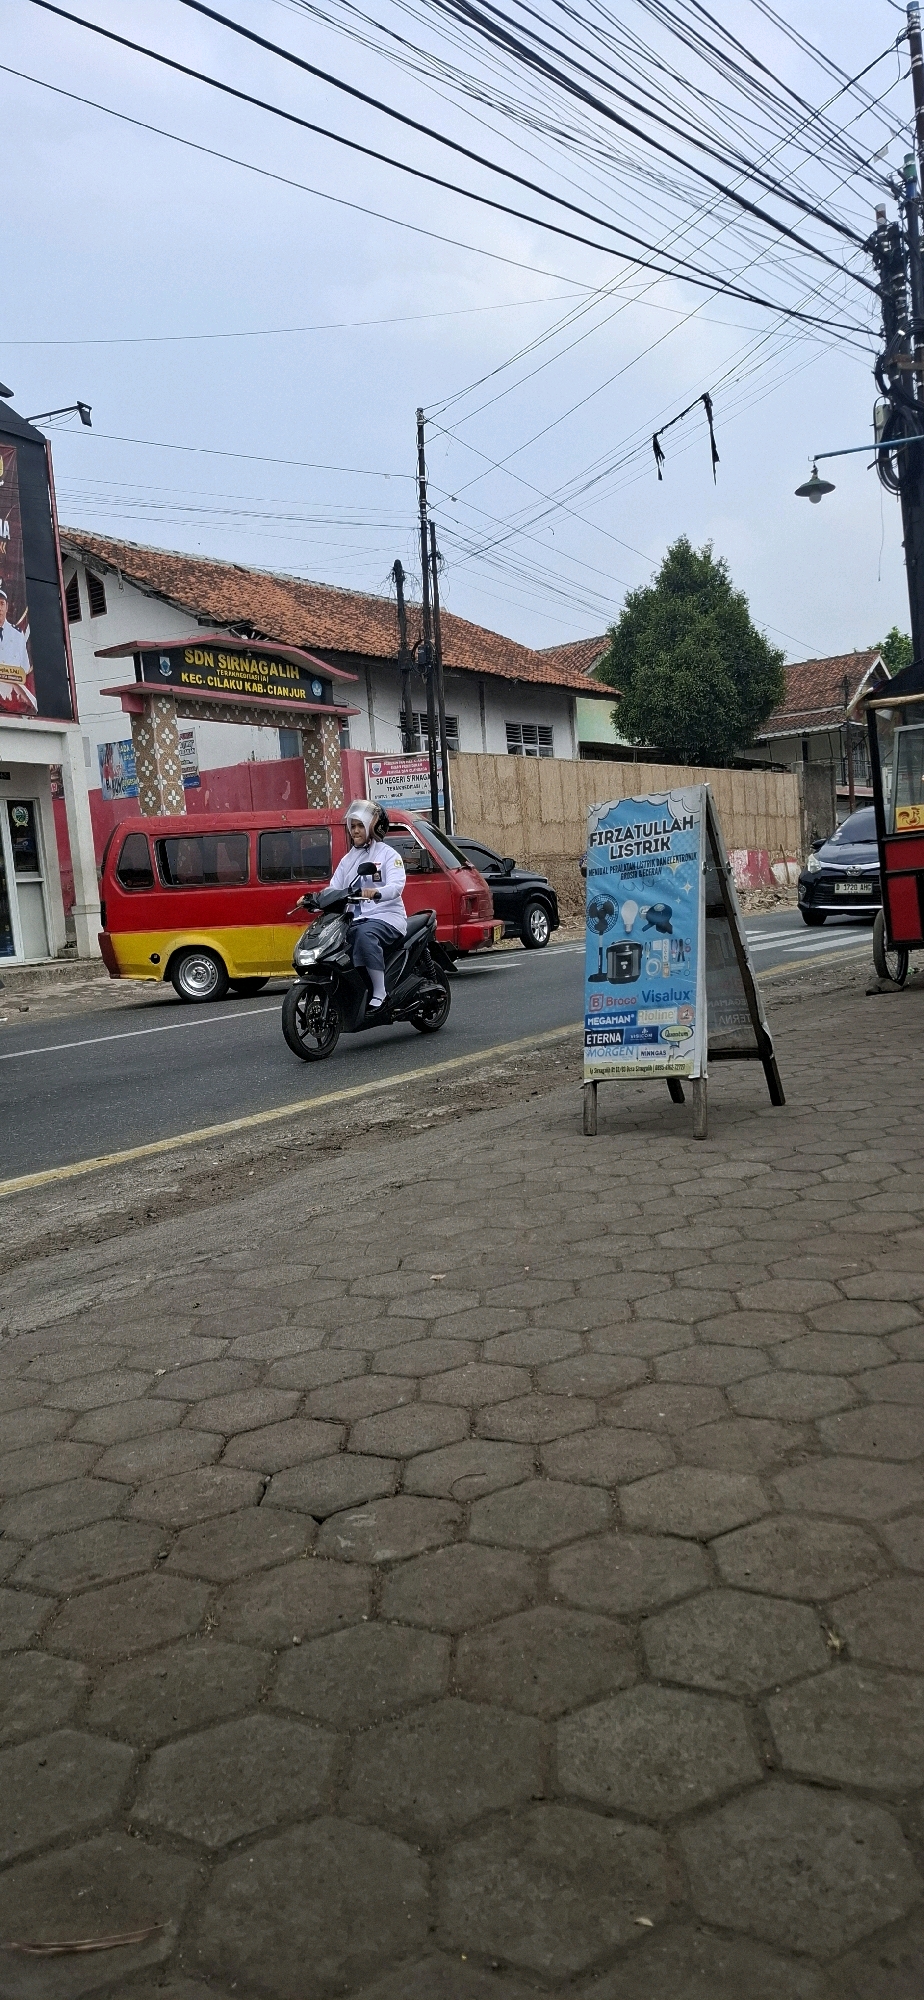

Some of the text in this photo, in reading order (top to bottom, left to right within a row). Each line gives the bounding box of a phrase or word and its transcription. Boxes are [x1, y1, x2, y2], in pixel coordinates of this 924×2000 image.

[184, 649, 300, 680] SDN SIRNAGALIH
[207, 675, 243, 690] CILAKU
[384, 775, 406, 784] NEGERI
[589, 815, 694, 847] FIRZATULLAH
[610, 836, 671, 860] LISTRIK
[605, 995, 638, 1007] Broco
[641, 987, 691, 1004] Visalux
[587, 1014, 632, 1026] MEGAMAN
[586, 1031, 622, 1045] ETERNA
[664, 1029, 690, 1038] Quantum
